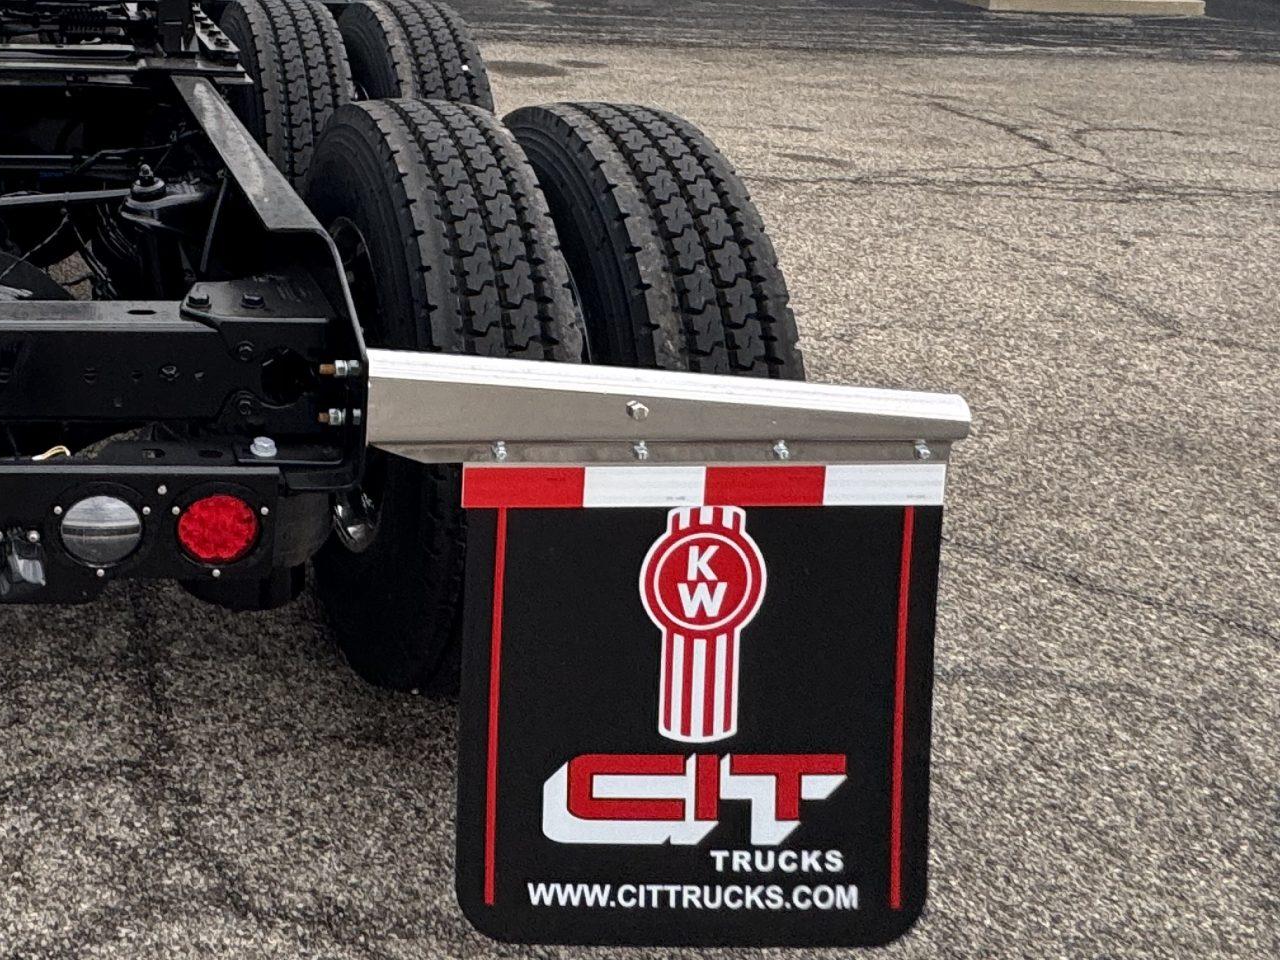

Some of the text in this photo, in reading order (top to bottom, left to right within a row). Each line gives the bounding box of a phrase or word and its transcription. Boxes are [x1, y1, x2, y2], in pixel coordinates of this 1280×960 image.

[687, 545, 720, 581] K
[676, 583, 728, 619] W
[565, 753, 847, 821] CIT
[710, 850, 844, 873] TRUCKS
[527, 882, 859, 909] WWW.CITTRUCKS.COM
